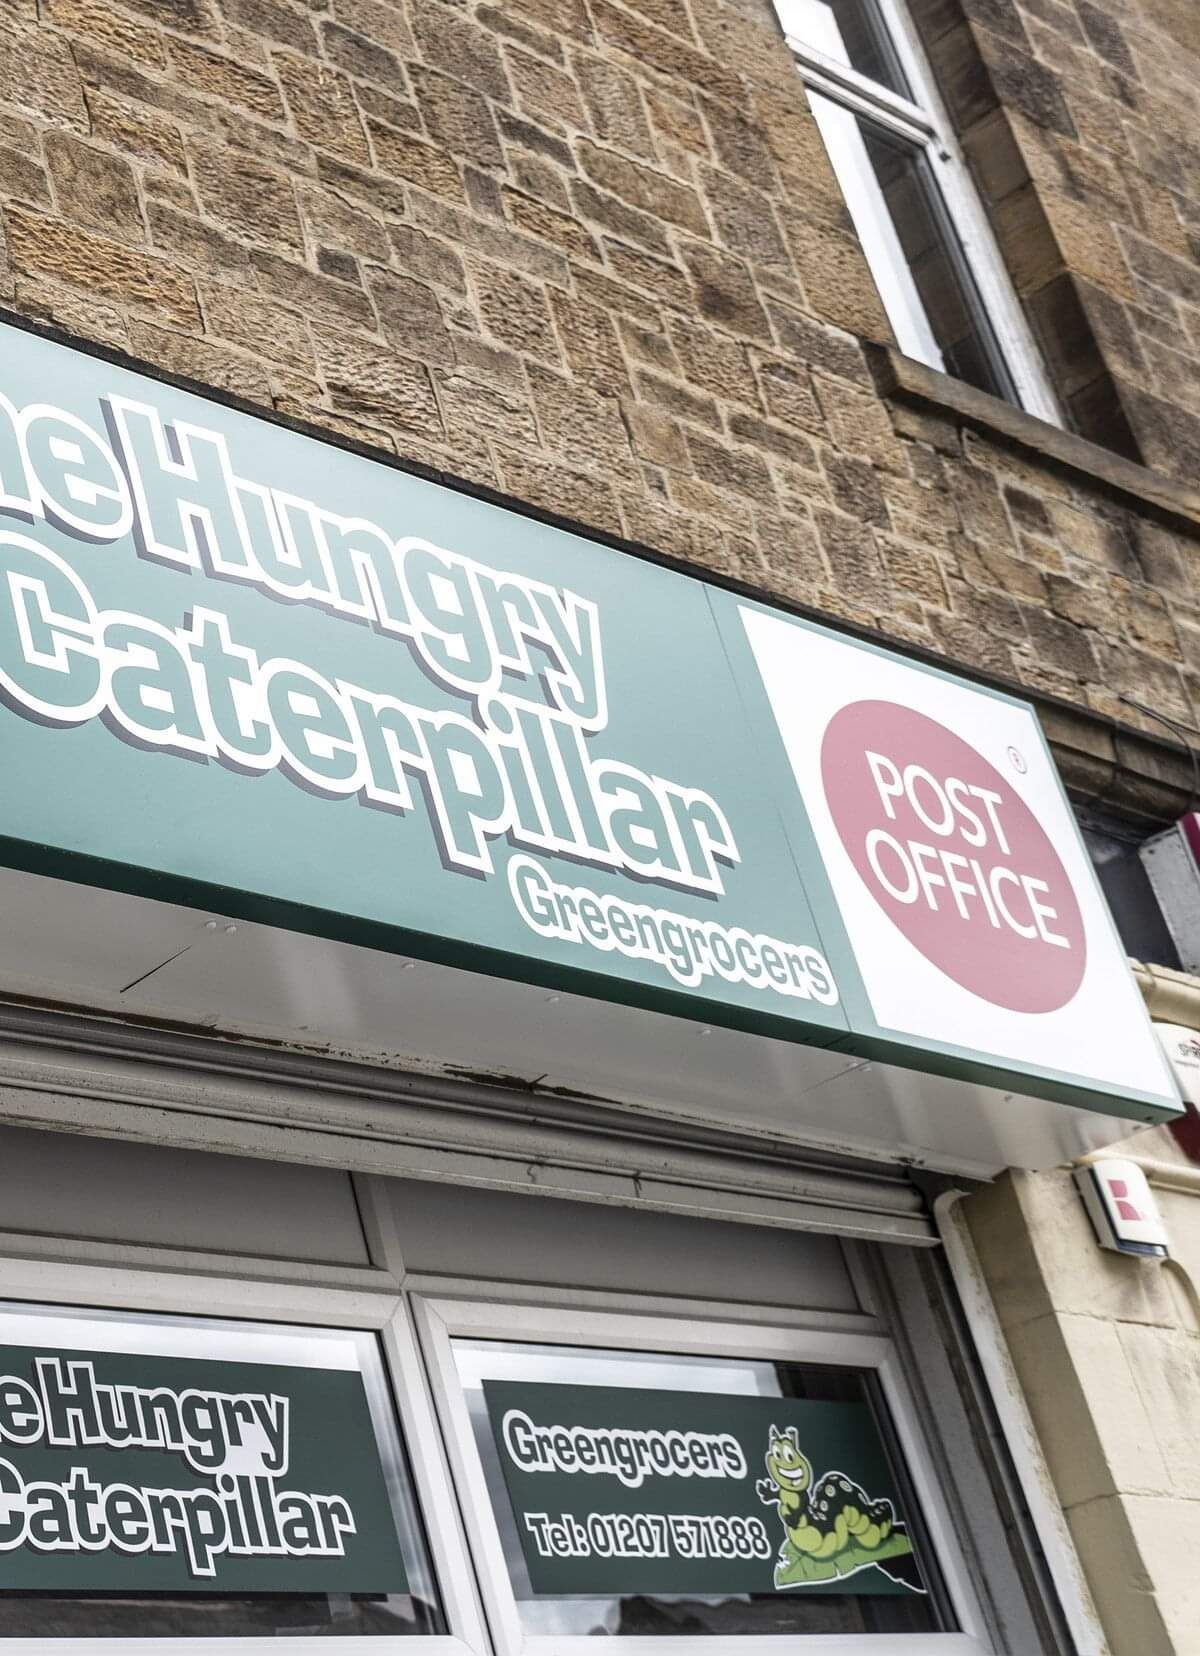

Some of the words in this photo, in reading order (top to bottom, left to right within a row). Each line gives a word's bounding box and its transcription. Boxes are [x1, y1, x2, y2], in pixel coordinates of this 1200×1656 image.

[110, 398, 608, 732] Hungry
[864, 750, 1003, 856] POST
[507, 854, 839, 1005] Greengrocers
[865, 829, 1071, 948] OFFICE
[35, 1356, 289, 1477] Hungry
[502, 1409, 747, 1487] Greengrocers
[524, 1512, 590, 1557] Tel:
[587, 1512, 670, 1558] 01207
[667, 1514, 772, 1559] 571888
